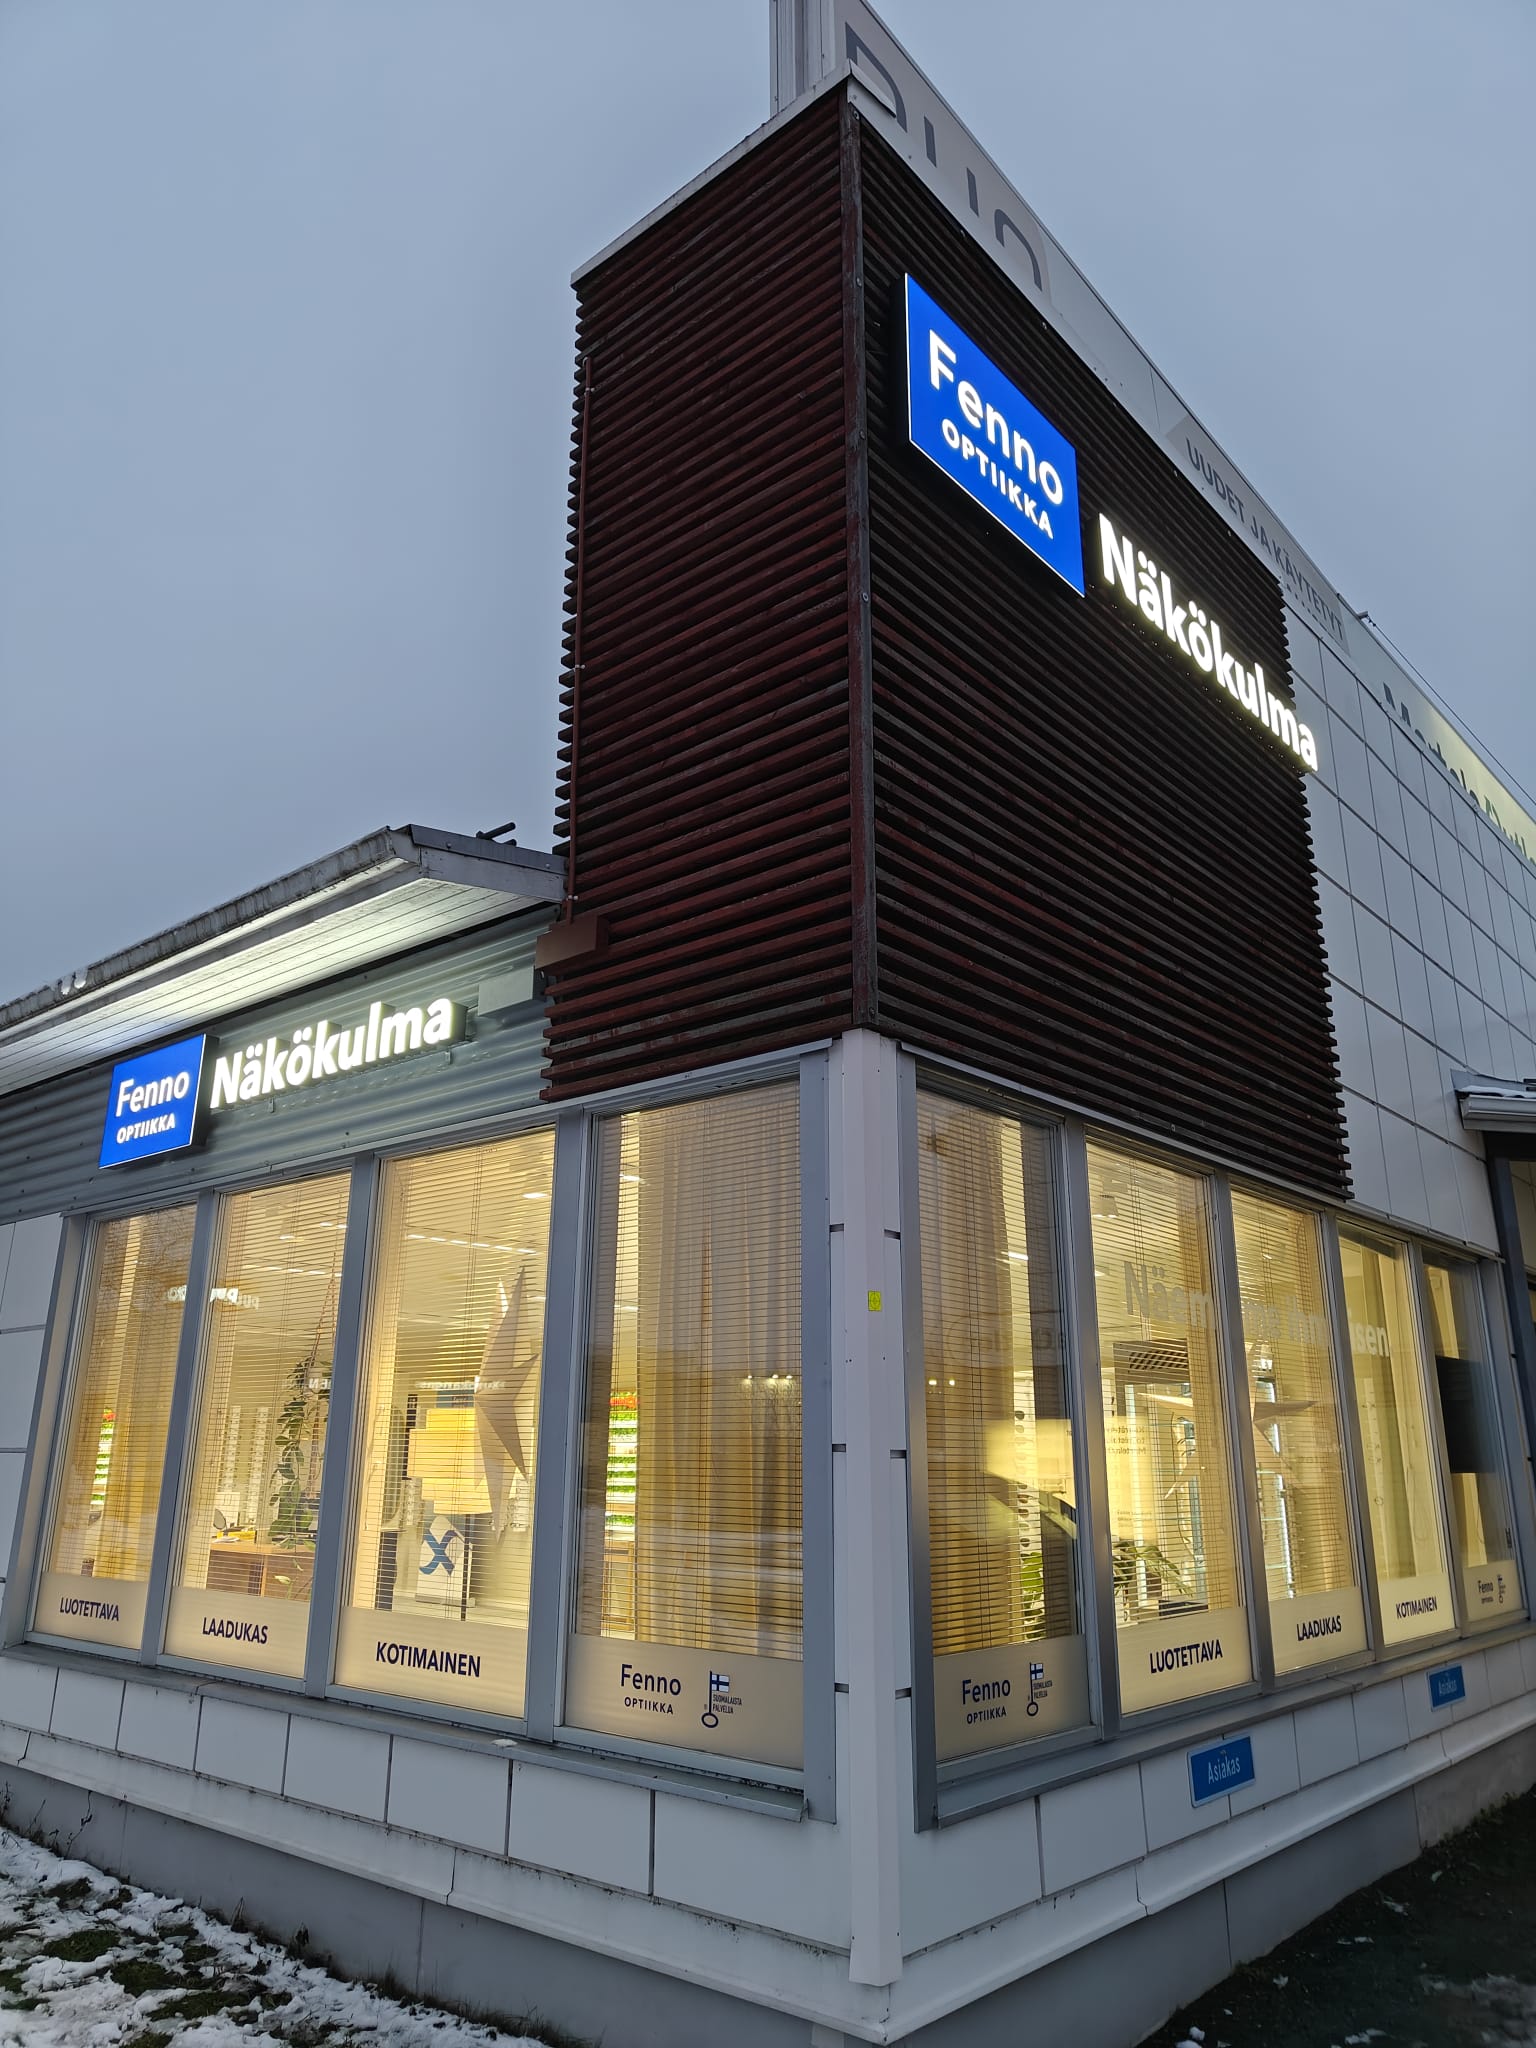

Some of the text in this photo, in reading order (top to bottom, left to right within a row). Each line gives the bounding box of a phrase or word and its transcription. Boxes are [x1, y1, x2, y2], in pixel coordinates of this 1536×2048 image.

[929, 329, 1063, 505] Fenno
[942, 418, 1055, 540] OPTIIKKA
[1186, 437, 1245, 524] UUDET
[1250, 516, 1272, 554] JA
[1099, 513, 1318, 771] Näkökulma
[209, 998, 452, 1109] Näkökulma
[115, 1071, 190, 1117] Fenno
[116, 1113, 176, 1144] OPTIIKKA
[59, 1596, 120, 1622] LUOTETTAVA
[1395, 1595, 1438, 1620] KOTIMAINEN
[202, 1616, 269, 1645] LAADUKAS
[1296, 1614, 1342, 1642] LAADUKAS
[375, 1641, 481, 1678] KOTIMAINEN
[1149, 1638, 1223, 1674] LUOTETTAVA
[620, 1663, 682, 1696] Fenno
[961, 1679, 1011, 1705] Fenno
[624, 1696, 674, 1715] OPTIIKKA
[966, 1706, 1007, 1725] OPTIIKKA
[1208, 1756, 1241, 1785] Asiakas
